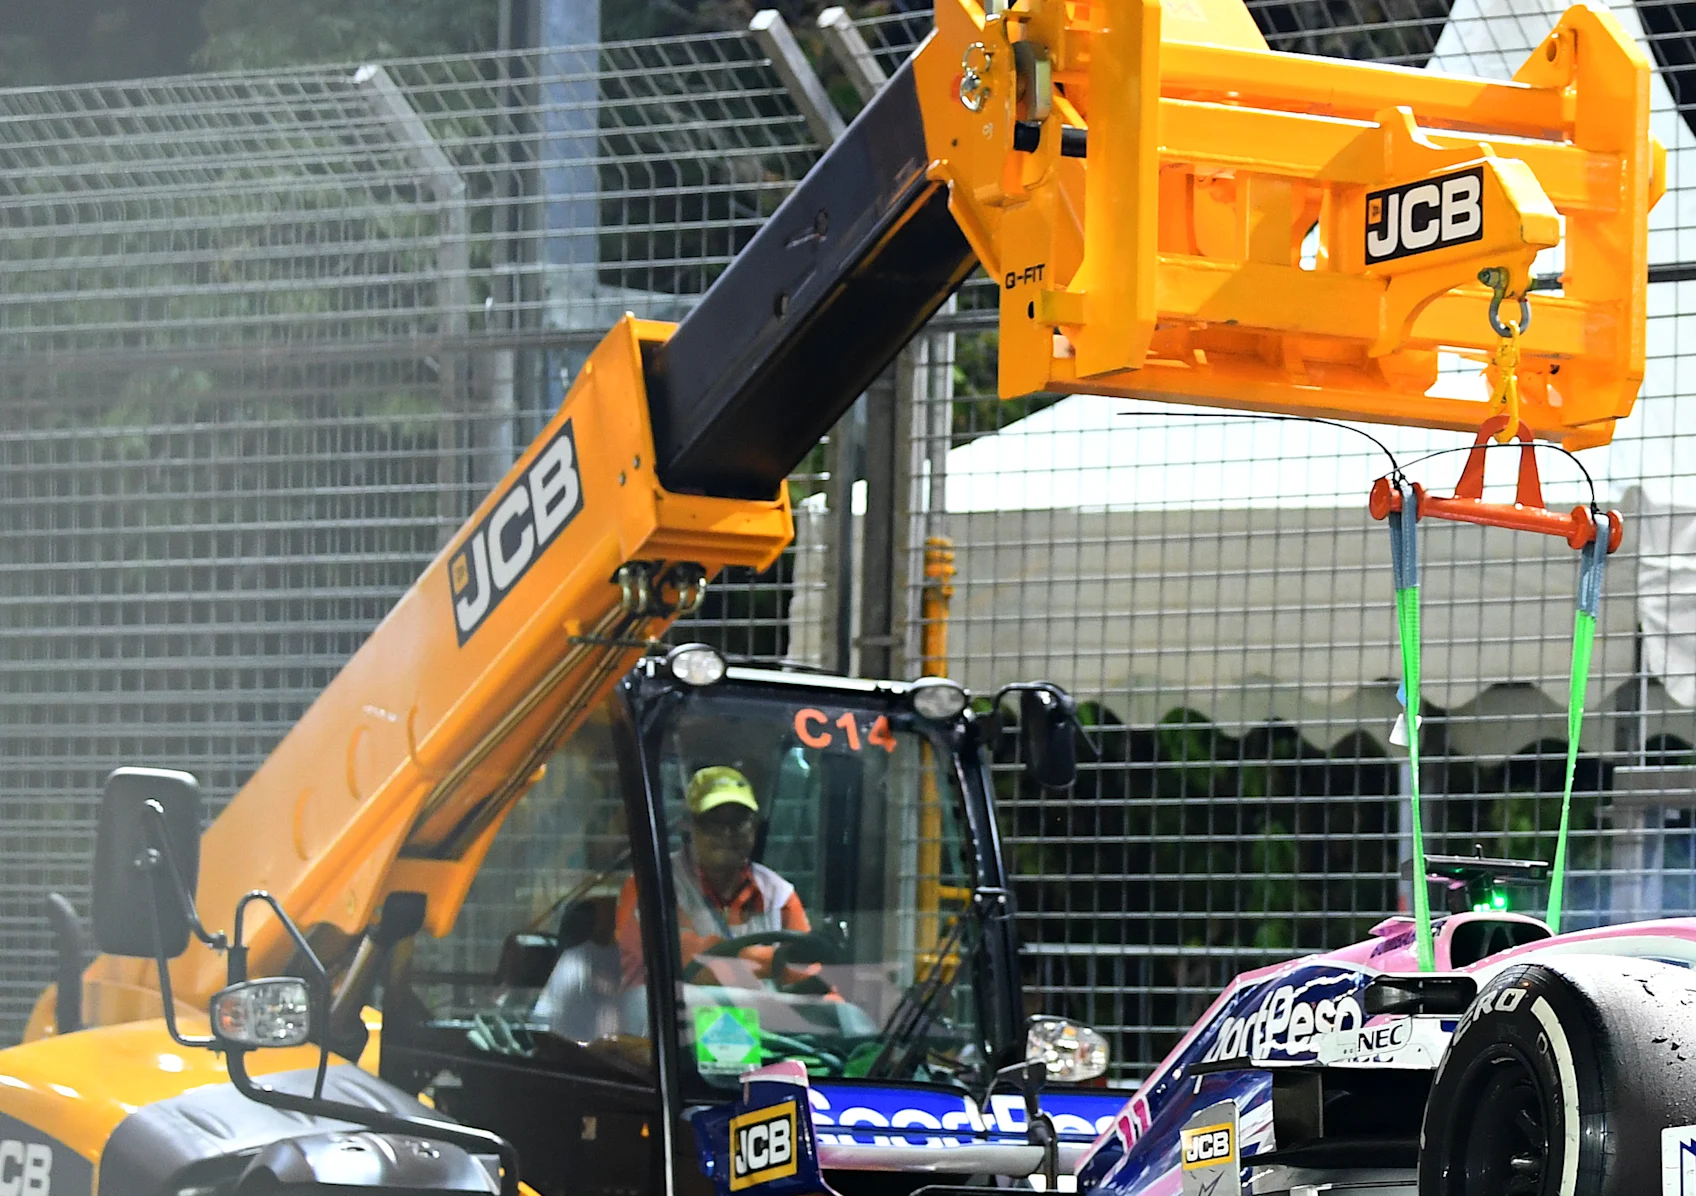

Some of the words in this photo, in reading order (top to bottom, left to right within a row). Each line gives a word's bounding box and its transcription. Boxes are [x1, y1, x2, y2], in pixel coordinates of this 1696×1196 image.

[1367, 175, 1481, 257] JCB
[1005, 263, 1046, 290] Q-FIT
[456, 435, 580, 632] JCB
[794, 708, 897, 752] C14
[1358, 1024, 1403, 1052] NEC
[735, 1118, 791, 1175] JCB
[1187, 1131, 1230, 1162] JCB
